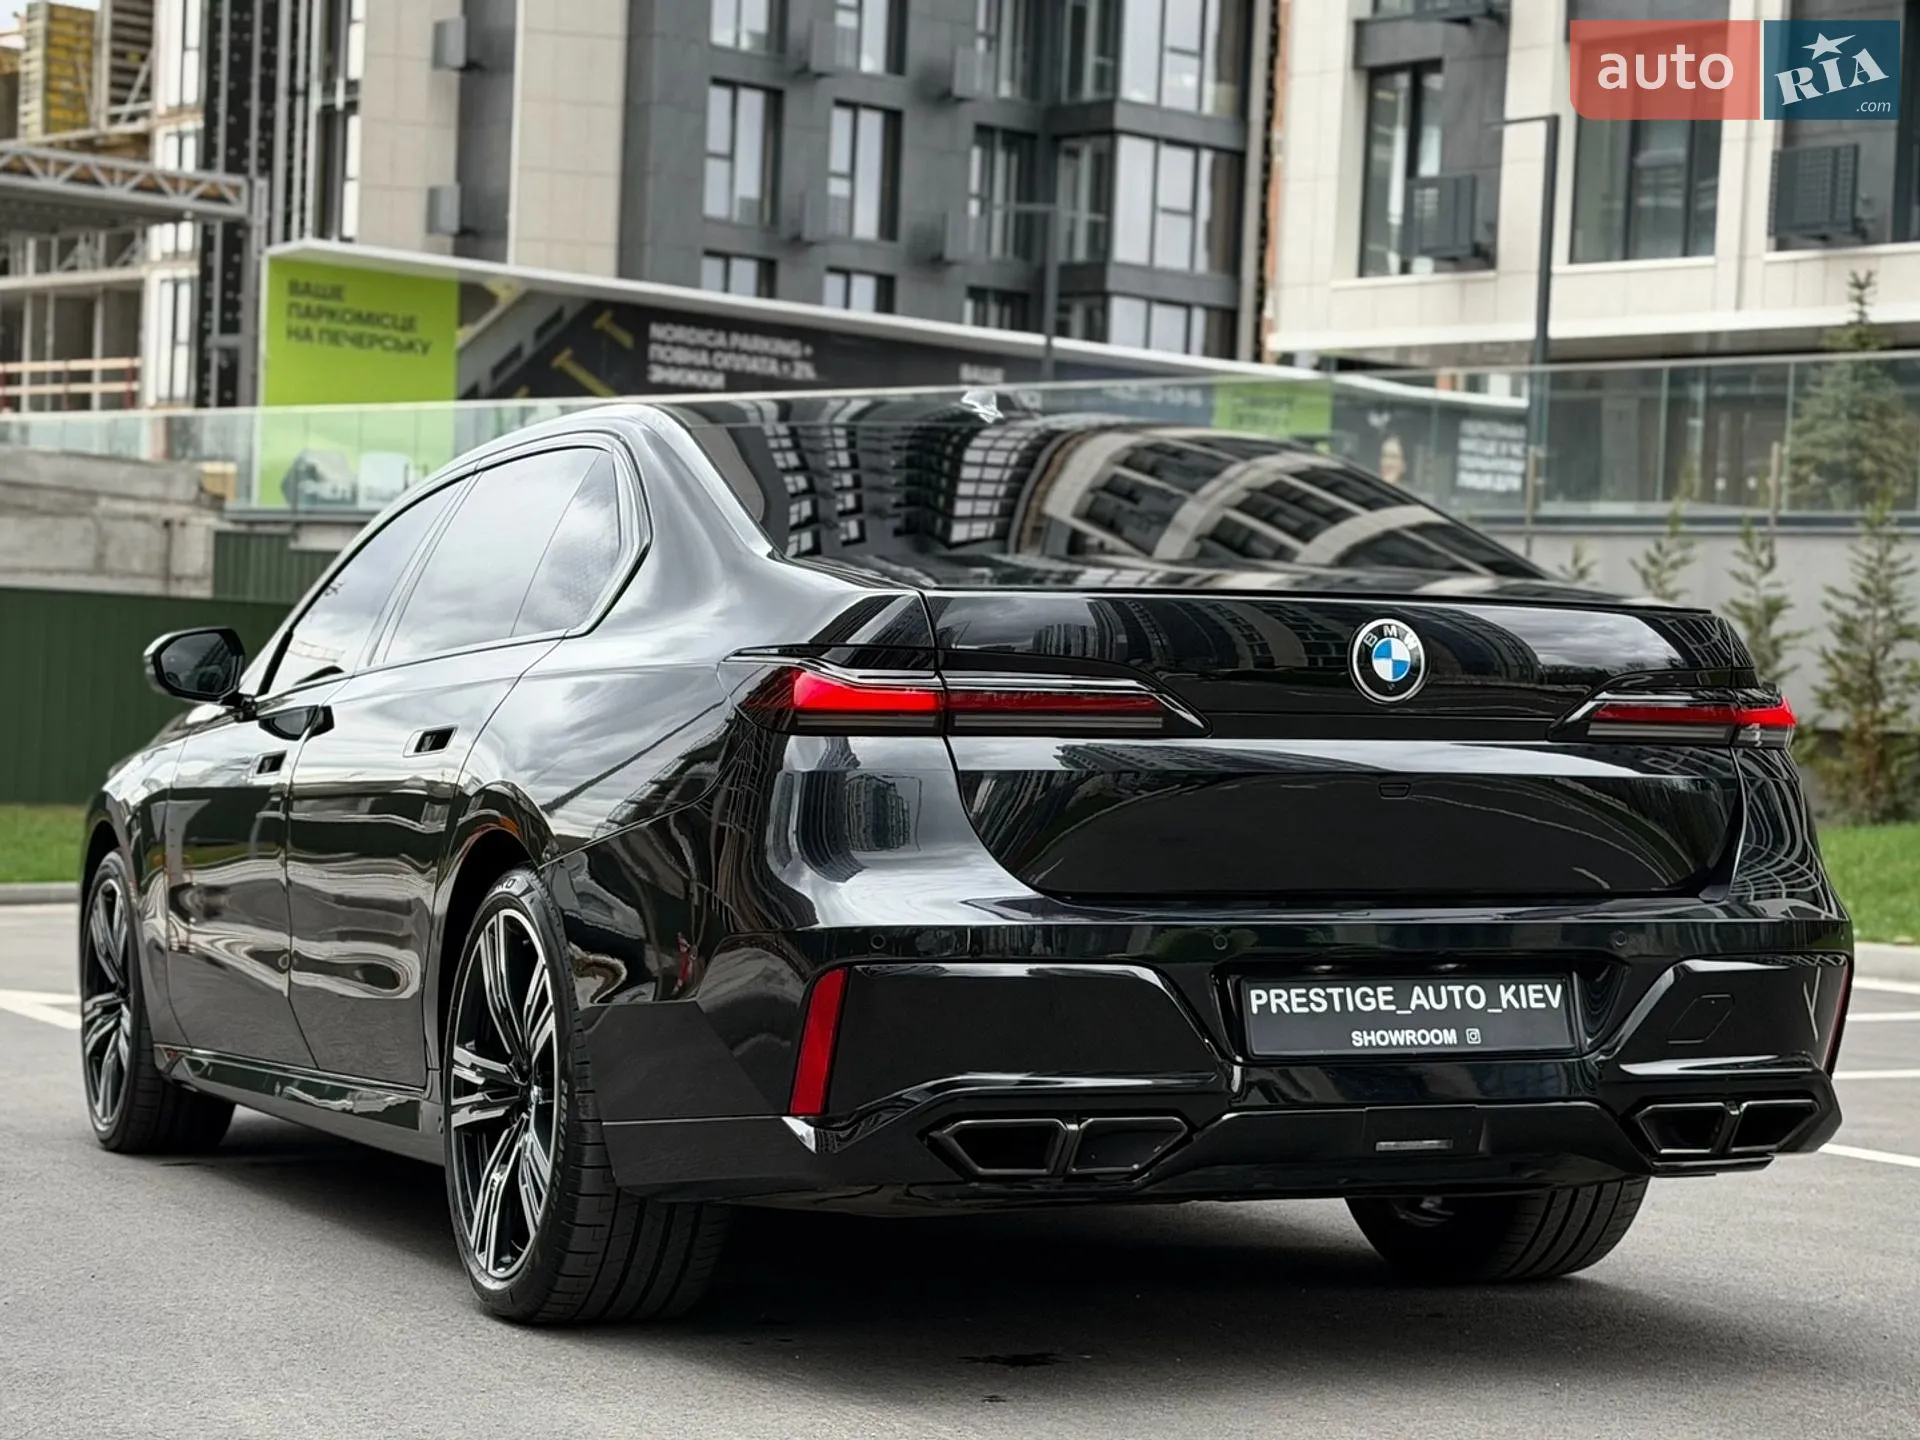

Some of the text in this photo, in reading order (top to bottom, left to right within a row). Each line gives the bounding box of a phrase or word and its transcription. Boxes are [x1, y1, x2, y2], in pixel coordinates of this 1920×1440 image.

[288, 278, 346, 302] ВАШЕ
[287, 302, 417, 333] ПАРКОМІСЦЕ
[287, 325, 433, 357] НА ПЕЧЕРСЬКУ
[1363, 625, 1418, 650] BMW
[1250, 984, 1563, 1014] PRESTIGE_AUTO_KIEV
[1351, 1029, 1457, 1046] SHOWROOM
